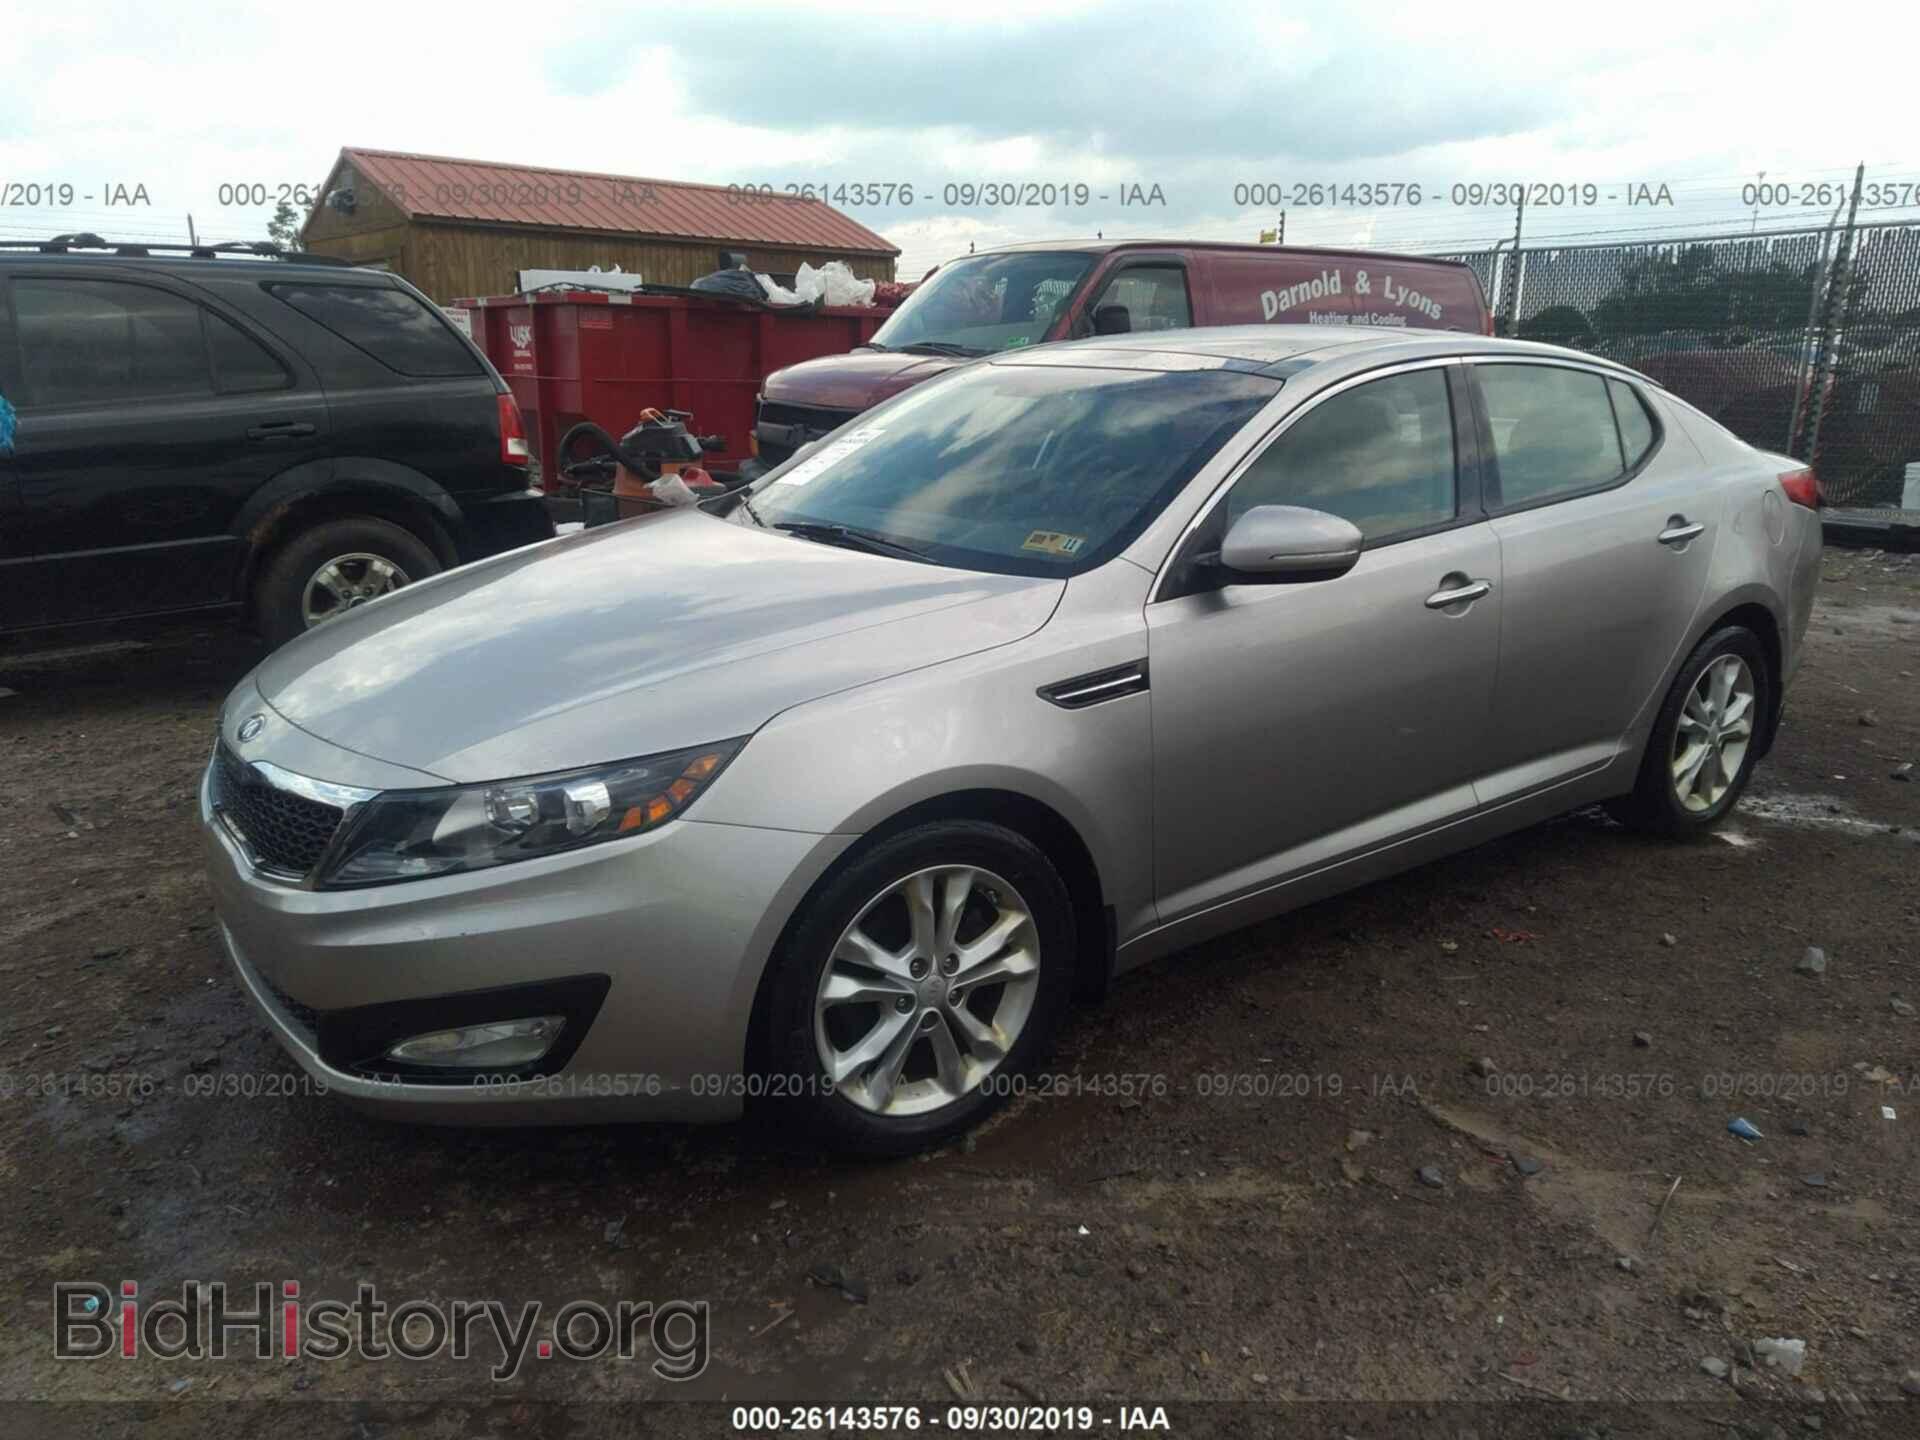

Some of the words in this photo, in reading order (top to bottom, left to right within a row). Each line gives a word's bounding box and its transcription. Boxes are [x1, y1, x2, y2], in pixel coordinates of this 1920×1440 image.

[1261, 269, 1342, 321] Darnold
[1355, 270, 1371, 295] &
[1384, 275, 1443, 320] Lyons
[1309, 311, 1348, 326] Heating
[1351, 312, 1370, 325] and
[1371, 313, 1407, 328] Cooling
